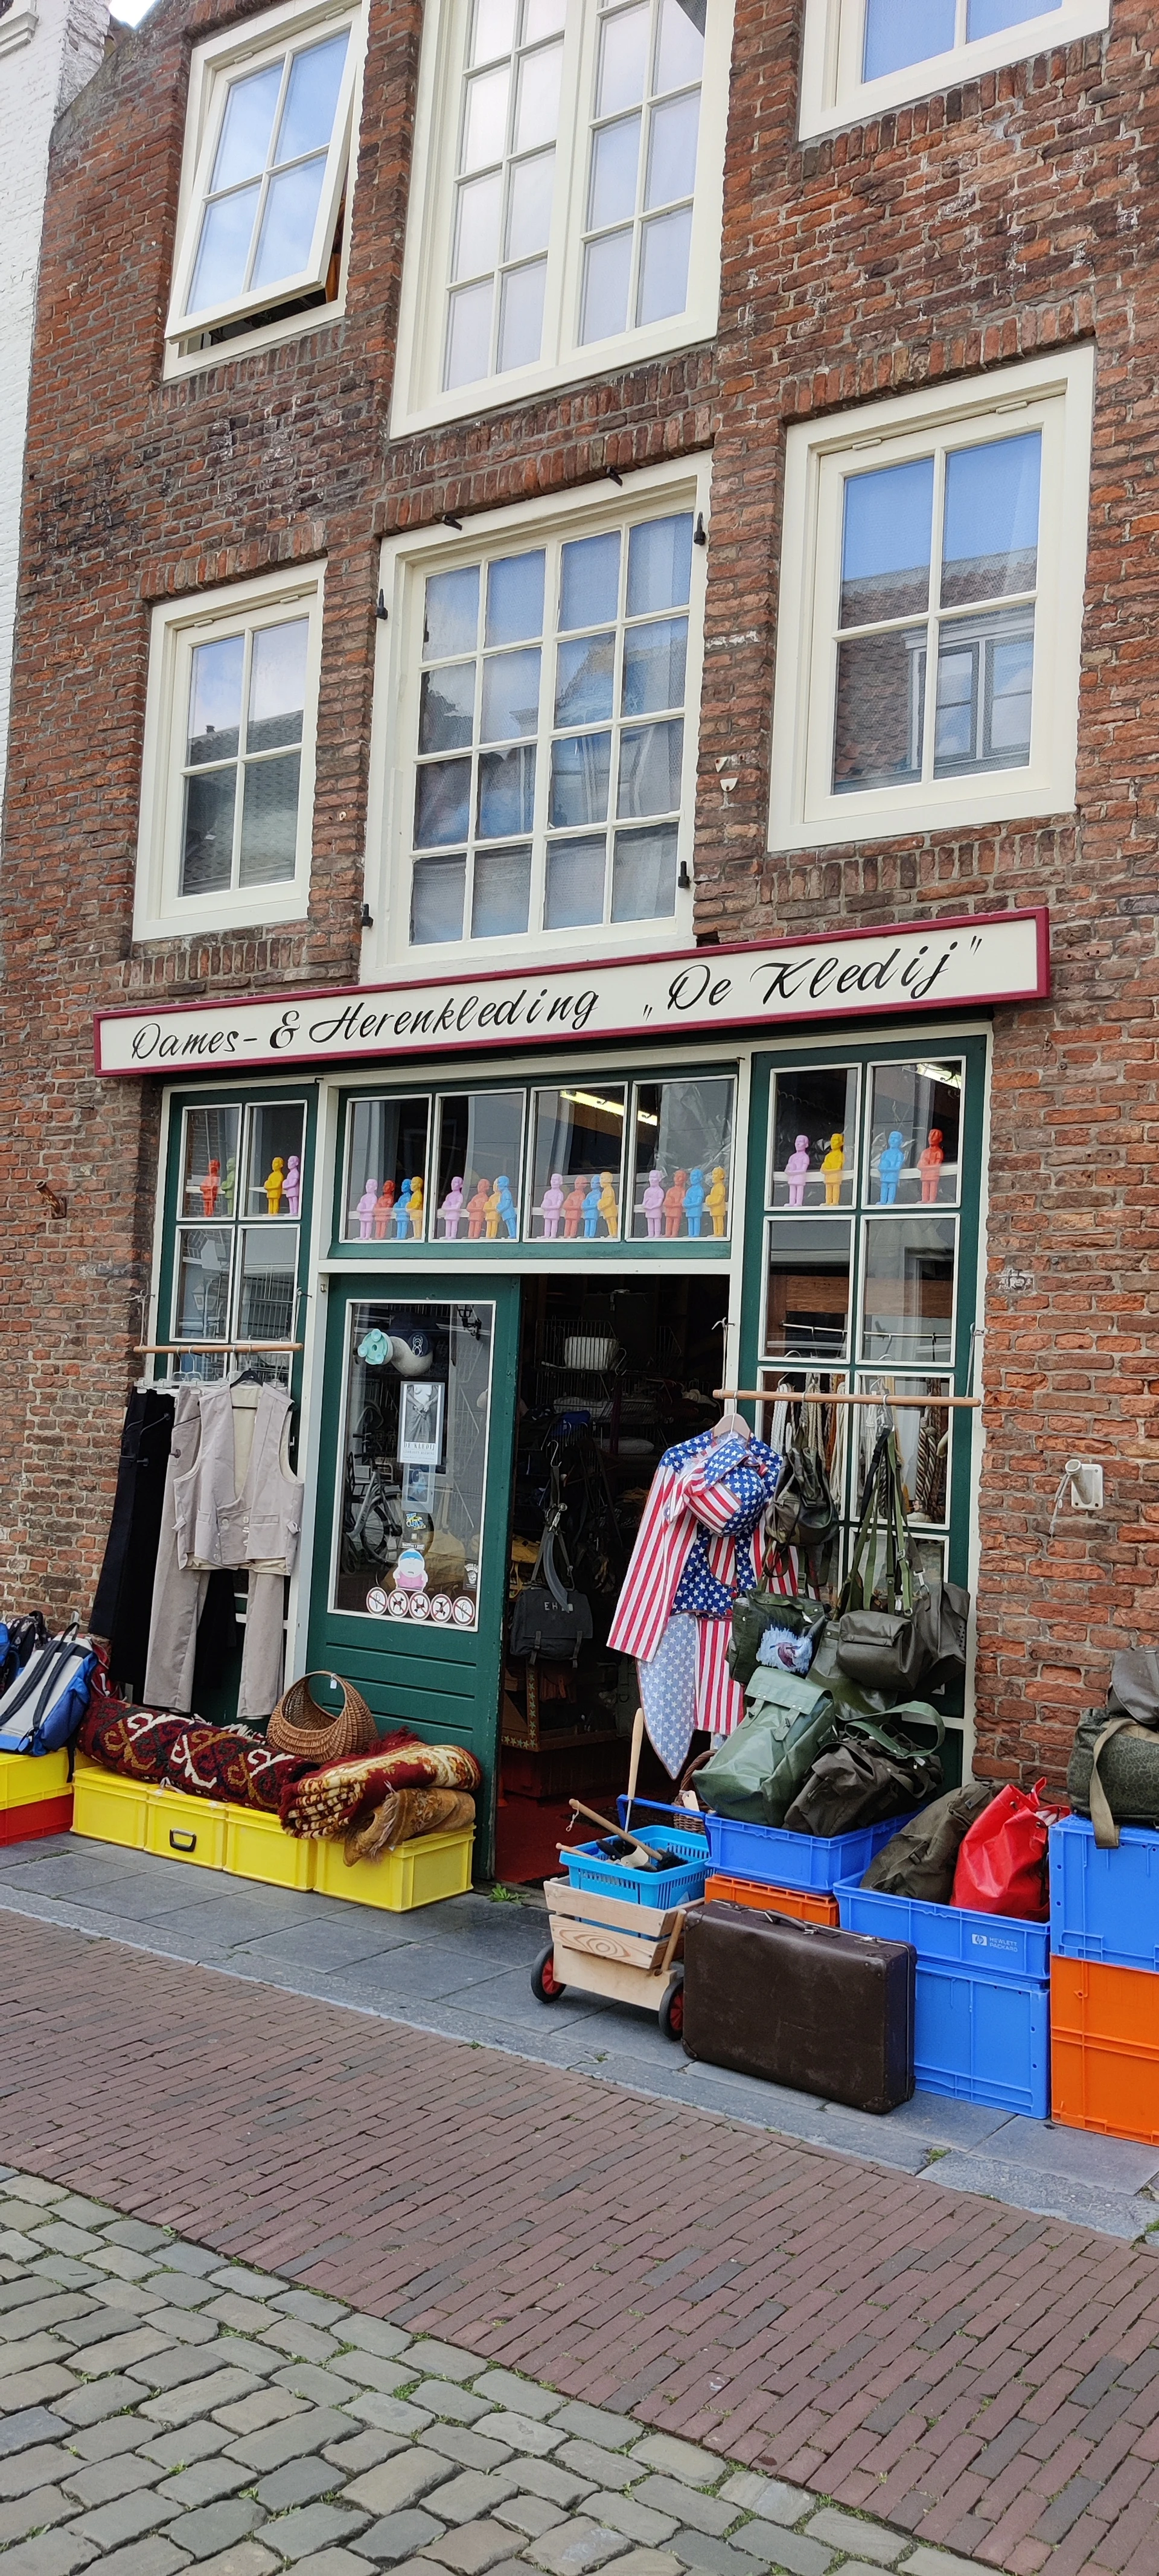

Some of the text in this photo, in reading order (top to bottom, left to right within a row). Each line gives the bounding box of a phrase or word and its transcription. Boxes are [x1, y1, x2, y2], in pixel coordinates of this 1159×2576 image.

[132, 1023, 258, 1059] Dames-
[269, 1010, 300, 1049] &
[308, 988, 599, 1043] Herenkleding
[989, 1937, 1017, 1946] HEWLETT
[989, 1943, 1018, 1952] PACKARD
